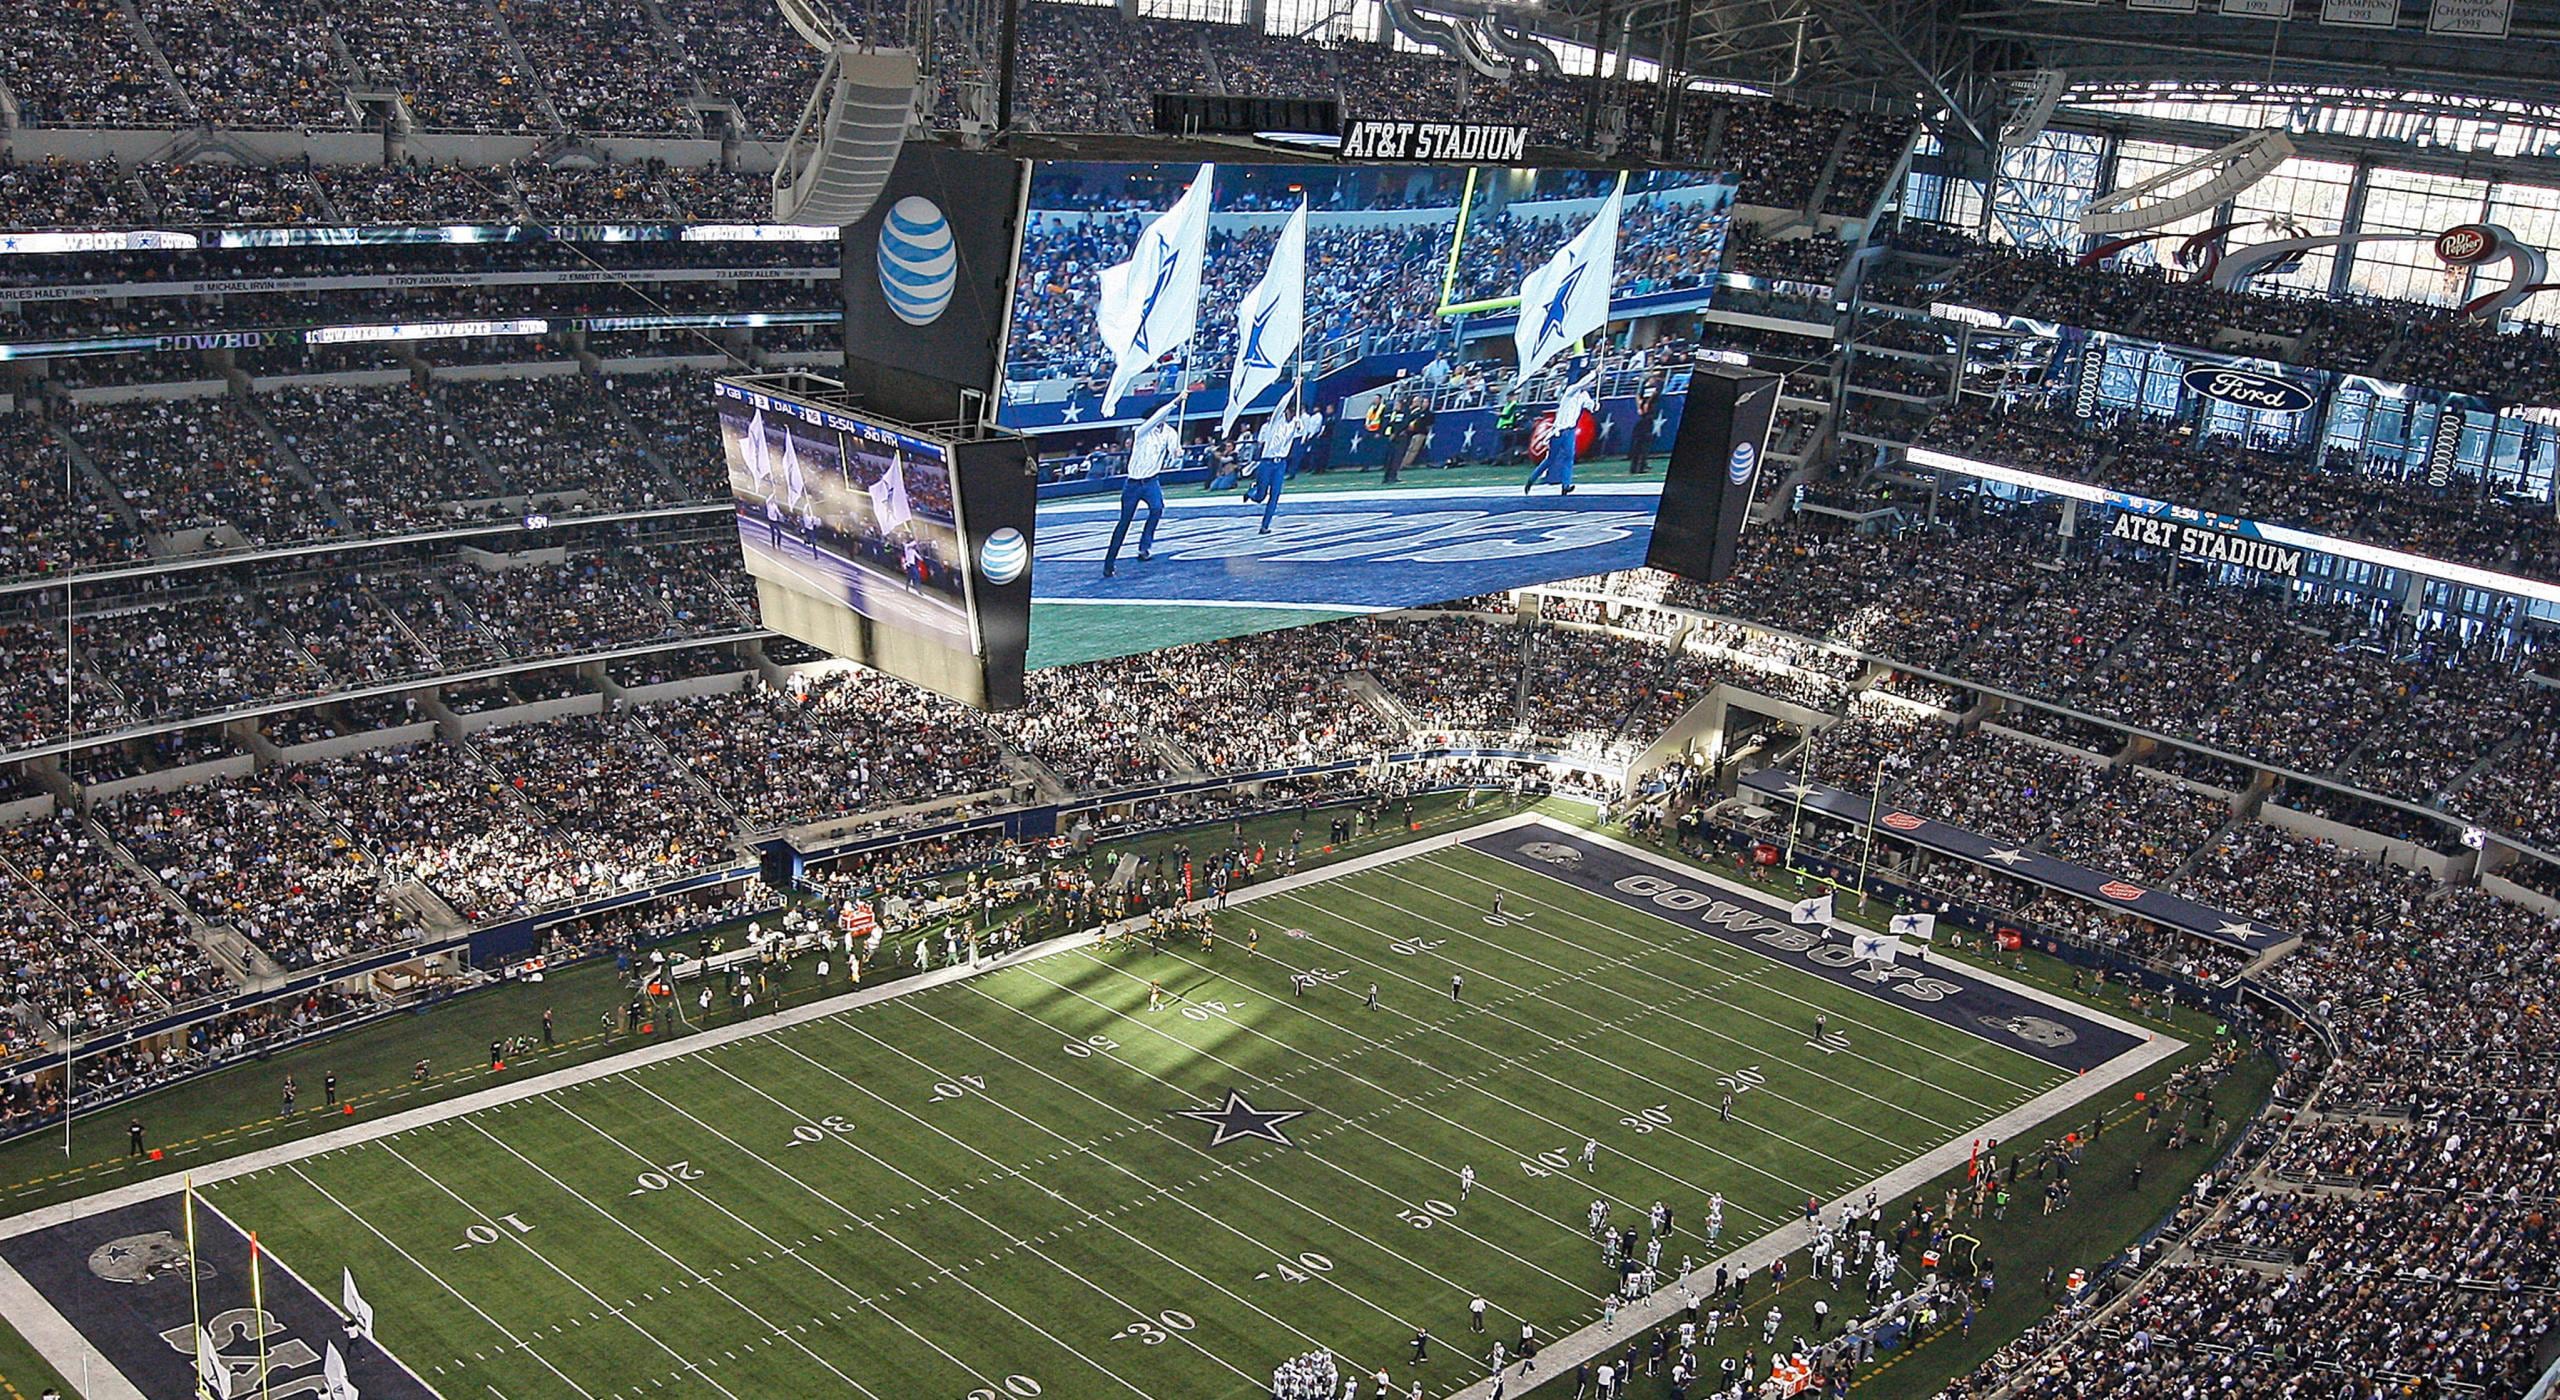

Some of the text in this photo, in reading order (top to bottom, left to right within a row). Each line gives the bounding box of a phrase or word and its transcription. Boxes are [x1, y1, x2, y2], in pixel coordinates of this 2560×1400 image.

[2246, 1, 2268, 11] 1992
[2349, 10, 2371, 20] 1993
[2437, 5, 2504, 18] CHAMPIONS
[1343, 121, 1528, 161] AT&T STADIUM
[2441, 236, 2480, 255] Pepper
[2457, 233, 2471, 244] Dr
[207, 283, 249, 292] MICHAEL
[250, 281, 274, 290] IRVIN
[728, 270, 755, 278] LARRY
[755, 269, 780, 277] ALLEN
[0, 289, 33, 300] ARLES
[35, 288, 69, 299] HALEY
[2209, 373, 2286, 407] Ford
[727, 387, 742, 400] GB
[774, 401, 796, 416] DAL
[827, 415, 856, 433] 5:54
[2112, 513, 2178, 548] AT&T
[2180, 527, 2300, 577] STADIUM
[1389, 936, 1438, 956] 20
[1614, 875, 1964, 1002] COWBOYS
[1181, 1000, 1230, 1021] 40
[1063, 1034, 1120, 1058] 50
[1805, 1033, 1851, 1055] 10
[933, 1074, 988, 1100] 40
[1715, 1068, 1766, 1094] 20
[793, 1114, 857, 1144] 30
[1619, 1107, 1673, 1134] 30
[635, 1160, 705, 1192] 20
[1519, 1150, 1570, 1179] 40
[1396, 1198, 1459, 1230] 50
[463, 1212, 538, 1247] 10
[1274, 1250, 1335, 1286] 40
[1126, 1308, 1197, 1345] 30
